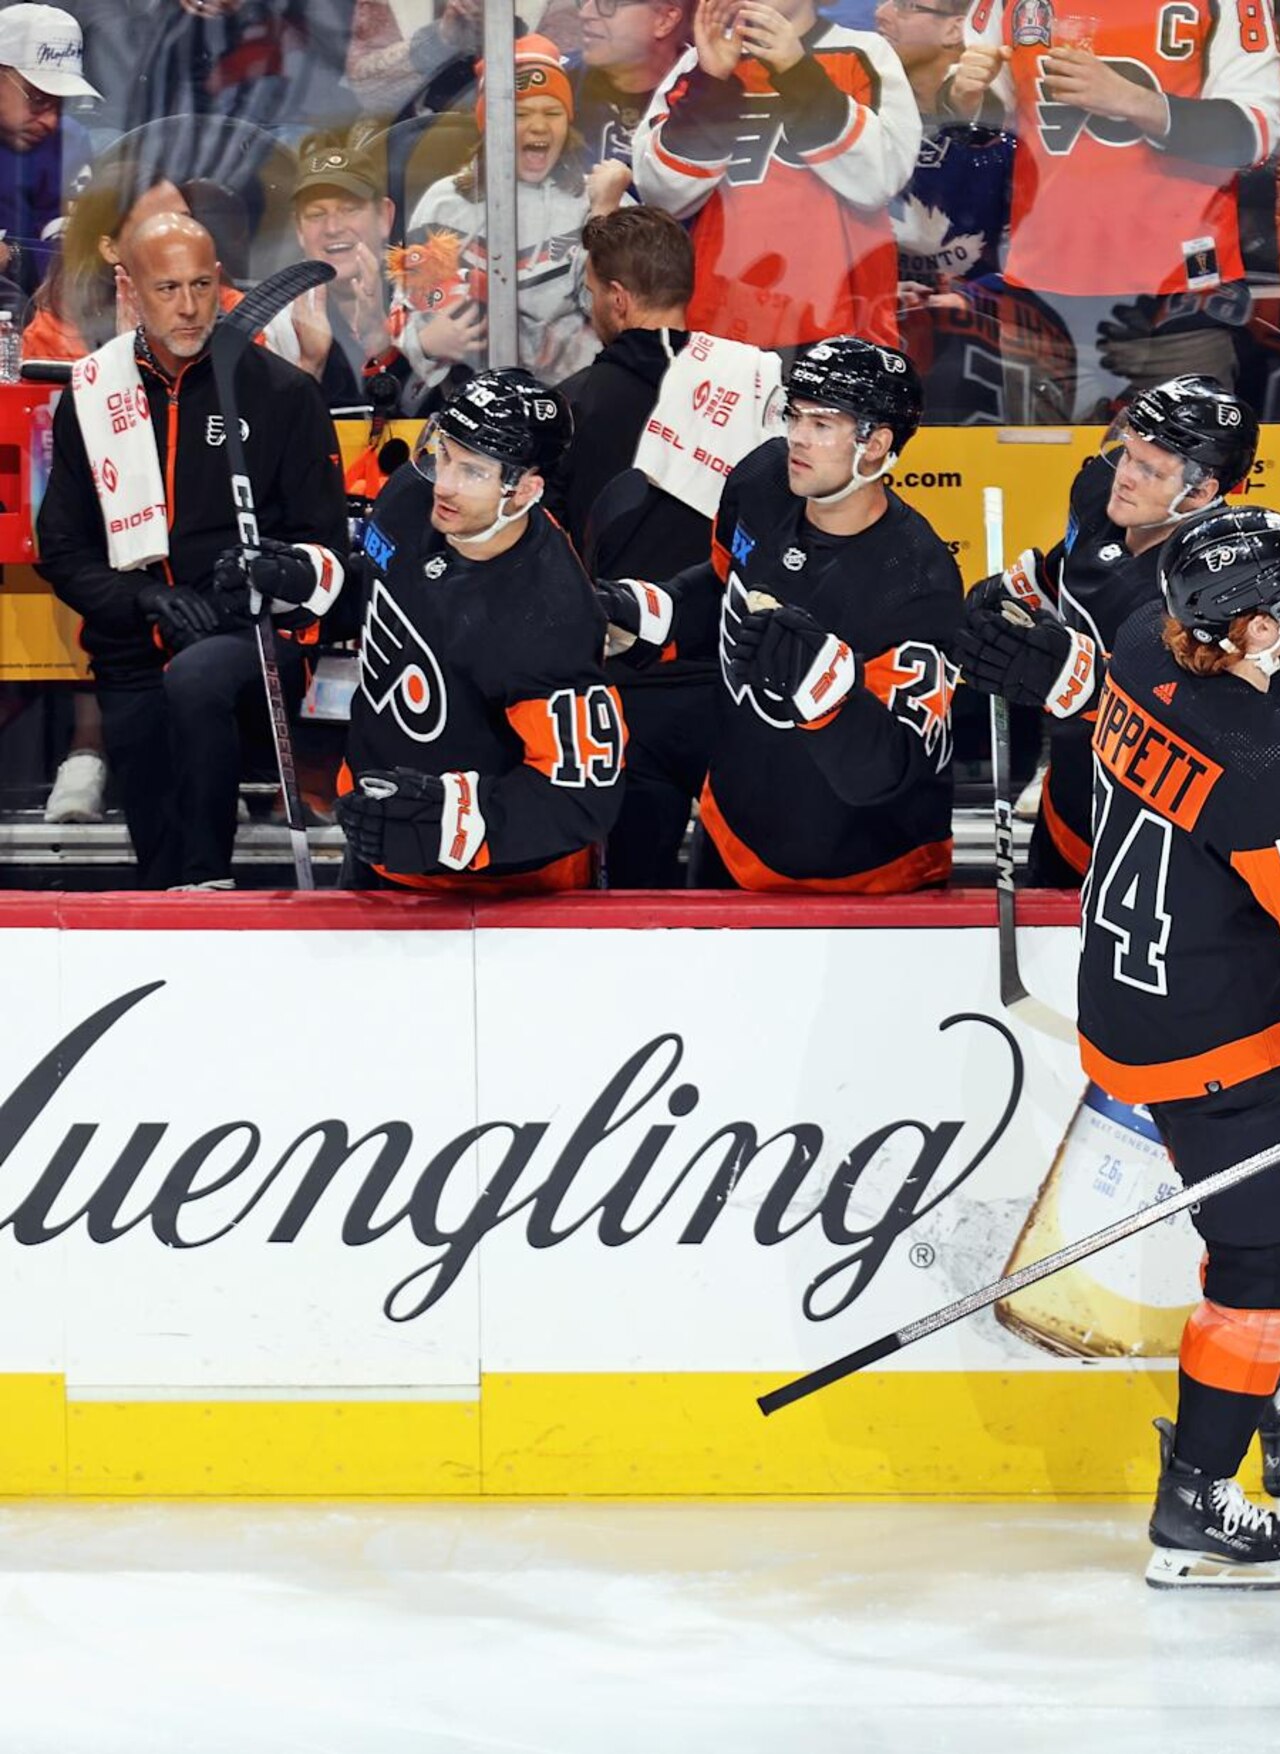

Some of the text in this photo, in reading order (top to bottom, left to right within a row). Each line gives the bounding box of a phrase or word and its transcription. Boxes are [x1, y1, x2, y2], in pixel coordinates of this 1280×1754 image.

[1157, 1, 1199, 60] C
[793, 370, 825, 384] CCM
[107, 393, 128, 435] BIO
[449, 407, 480, 431] CCM
[711, 390, 741, 428] BIO
[1139, 401, 1165, 423] CCM
[1057, 631, 1095, 711] CCM
[547, 685, 624, 788] 19
[994, 799, 1015, 893] CCM
[1113, 1130, 1167, 1163] GENERAT
